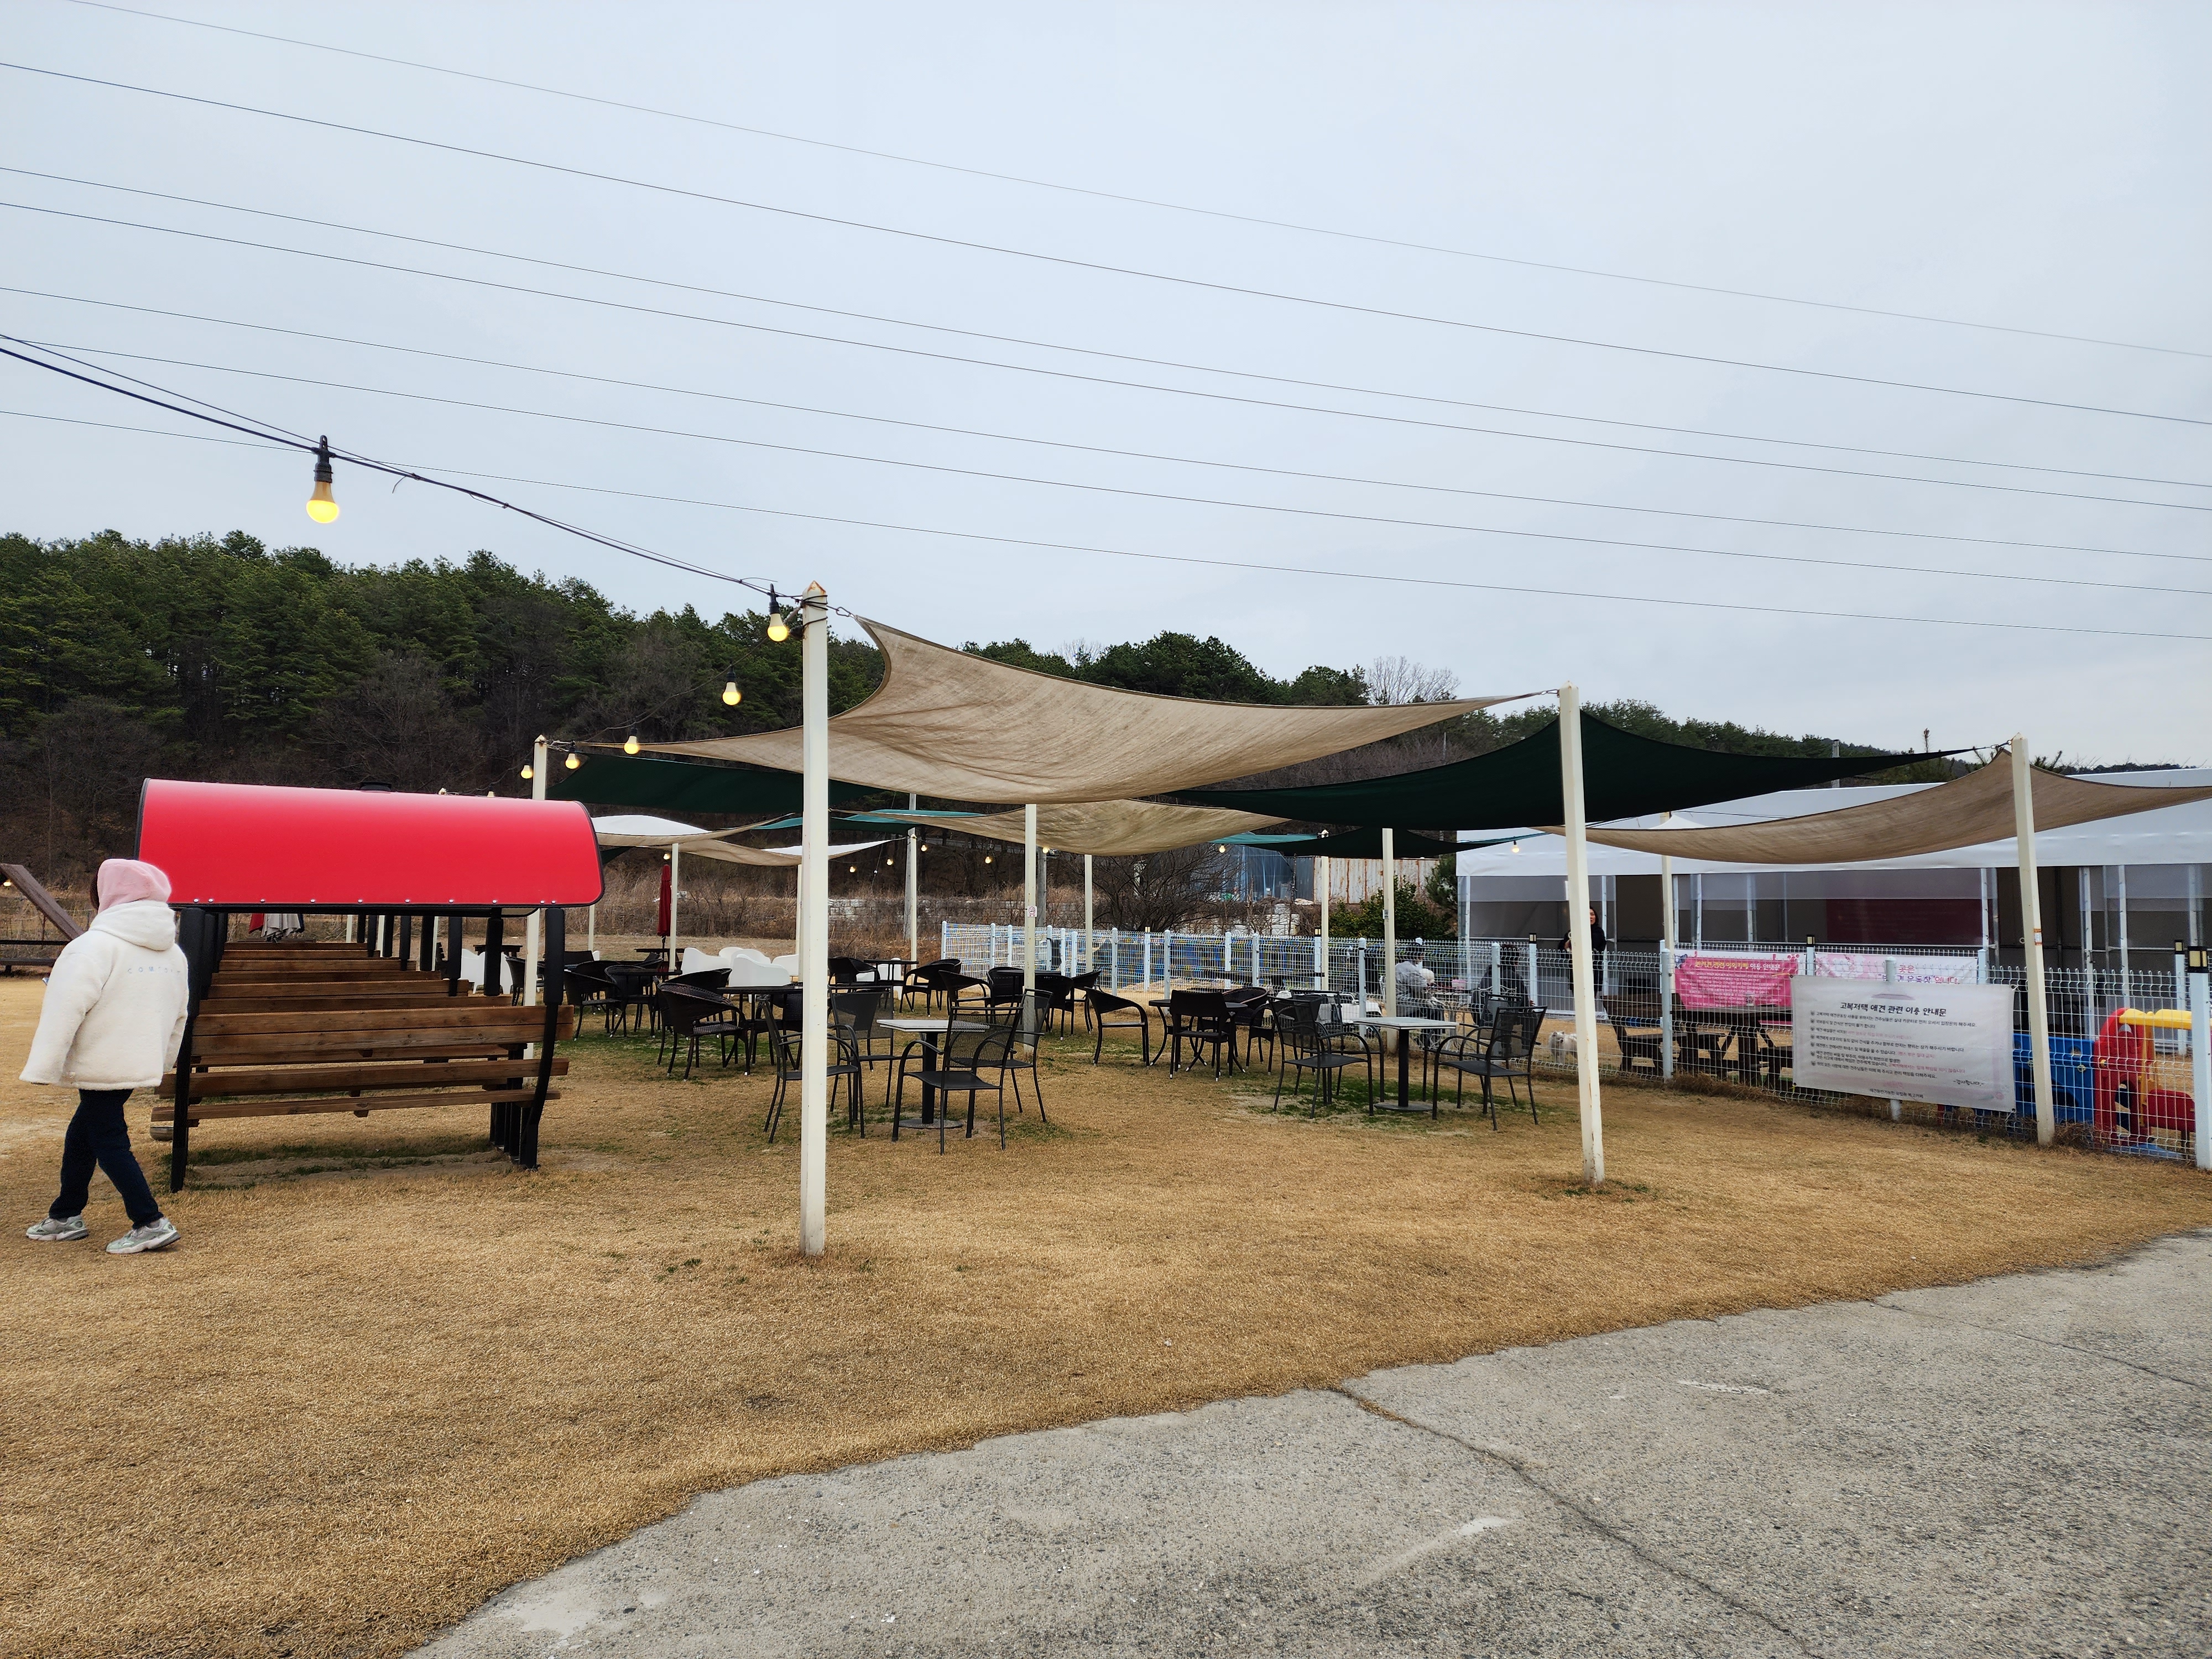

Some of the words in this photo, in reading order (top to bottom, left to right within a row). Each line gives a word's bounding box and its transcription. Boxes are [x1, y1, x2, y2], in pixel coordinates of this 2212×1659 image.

[1840, 1002, 1869, 1011] 고복저택
[1888, 1005, 1903, 1014] 관련
[1906, 1007, 1920, 1015] 이용
[1923, 1008, 1947, 1016] 안내문
